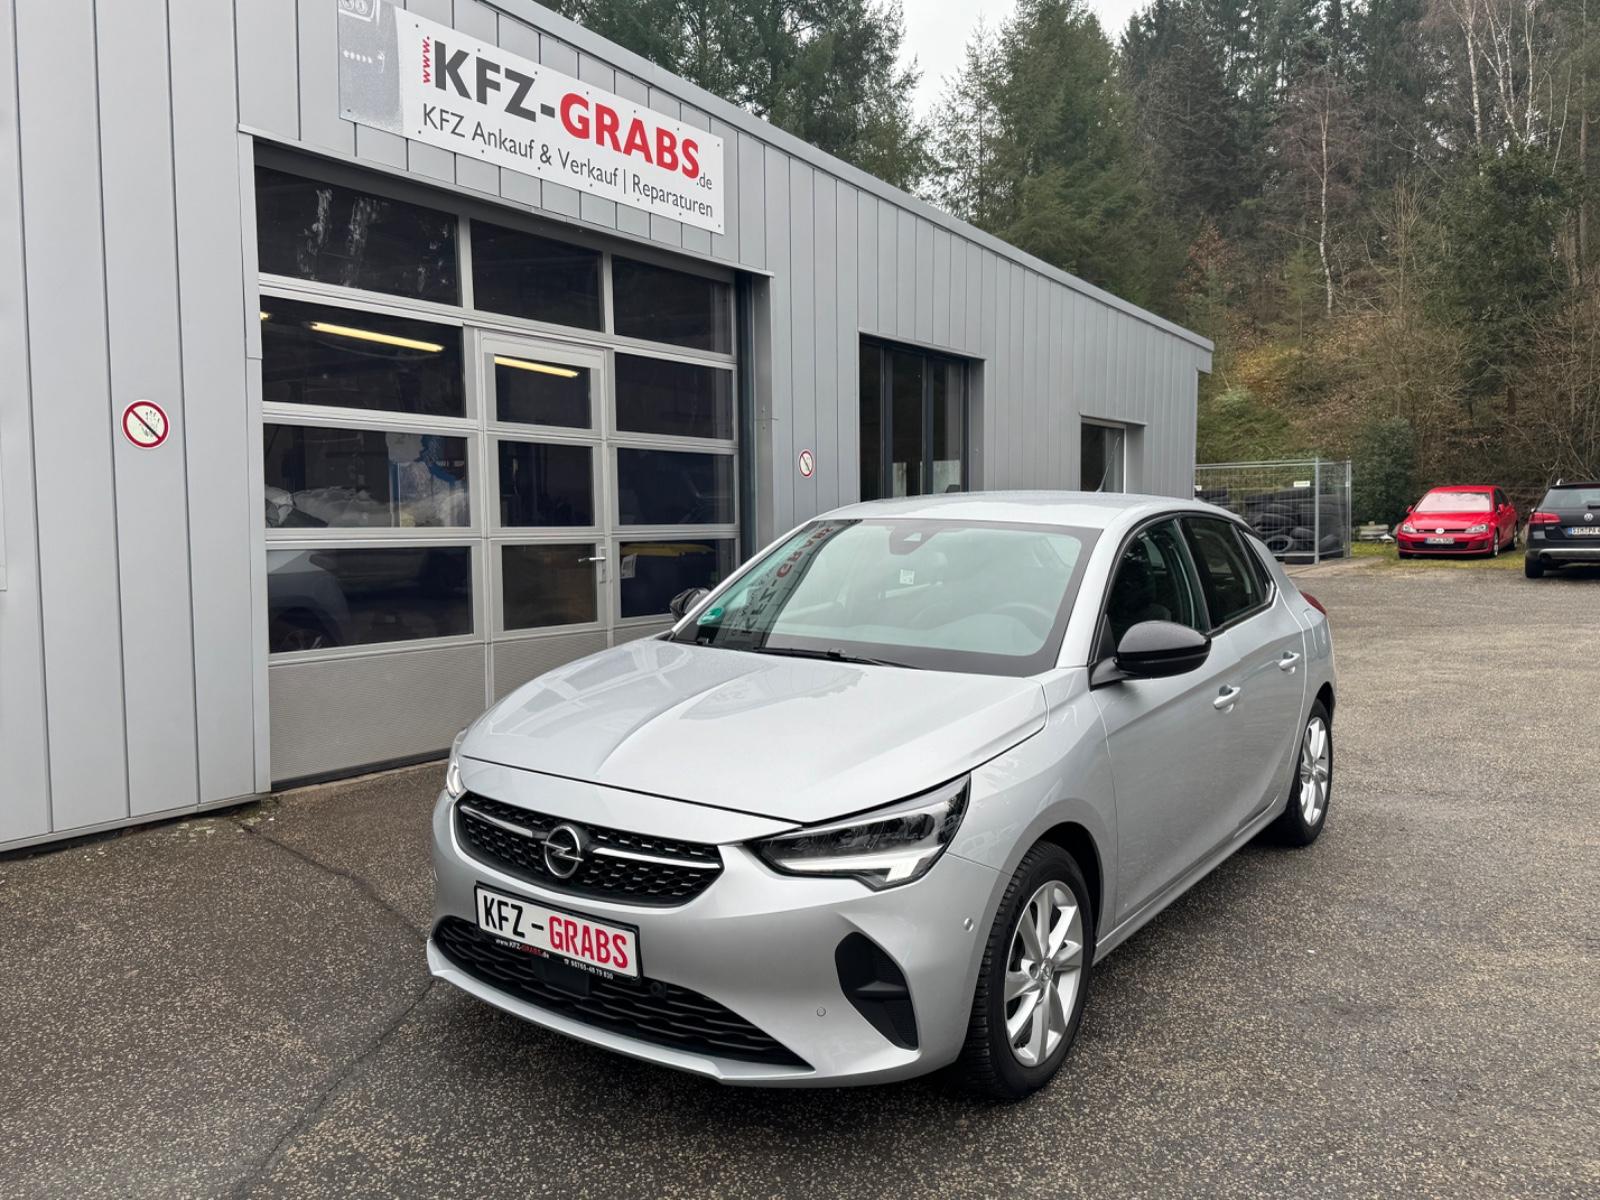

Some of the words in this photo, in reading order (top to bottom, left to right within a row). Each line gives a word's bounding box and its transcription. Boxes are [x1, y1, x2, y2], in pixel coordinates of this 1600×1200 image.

[422, 36, 431, 84] www.
[423, 103, 466, 138] KFZ
[471, 121, 536, 161] Ankauf
[540, 144, 553, 165] &
[557, 147, 619, 187] Verkauf
[632, 173, 713, 218] Reparaturen
